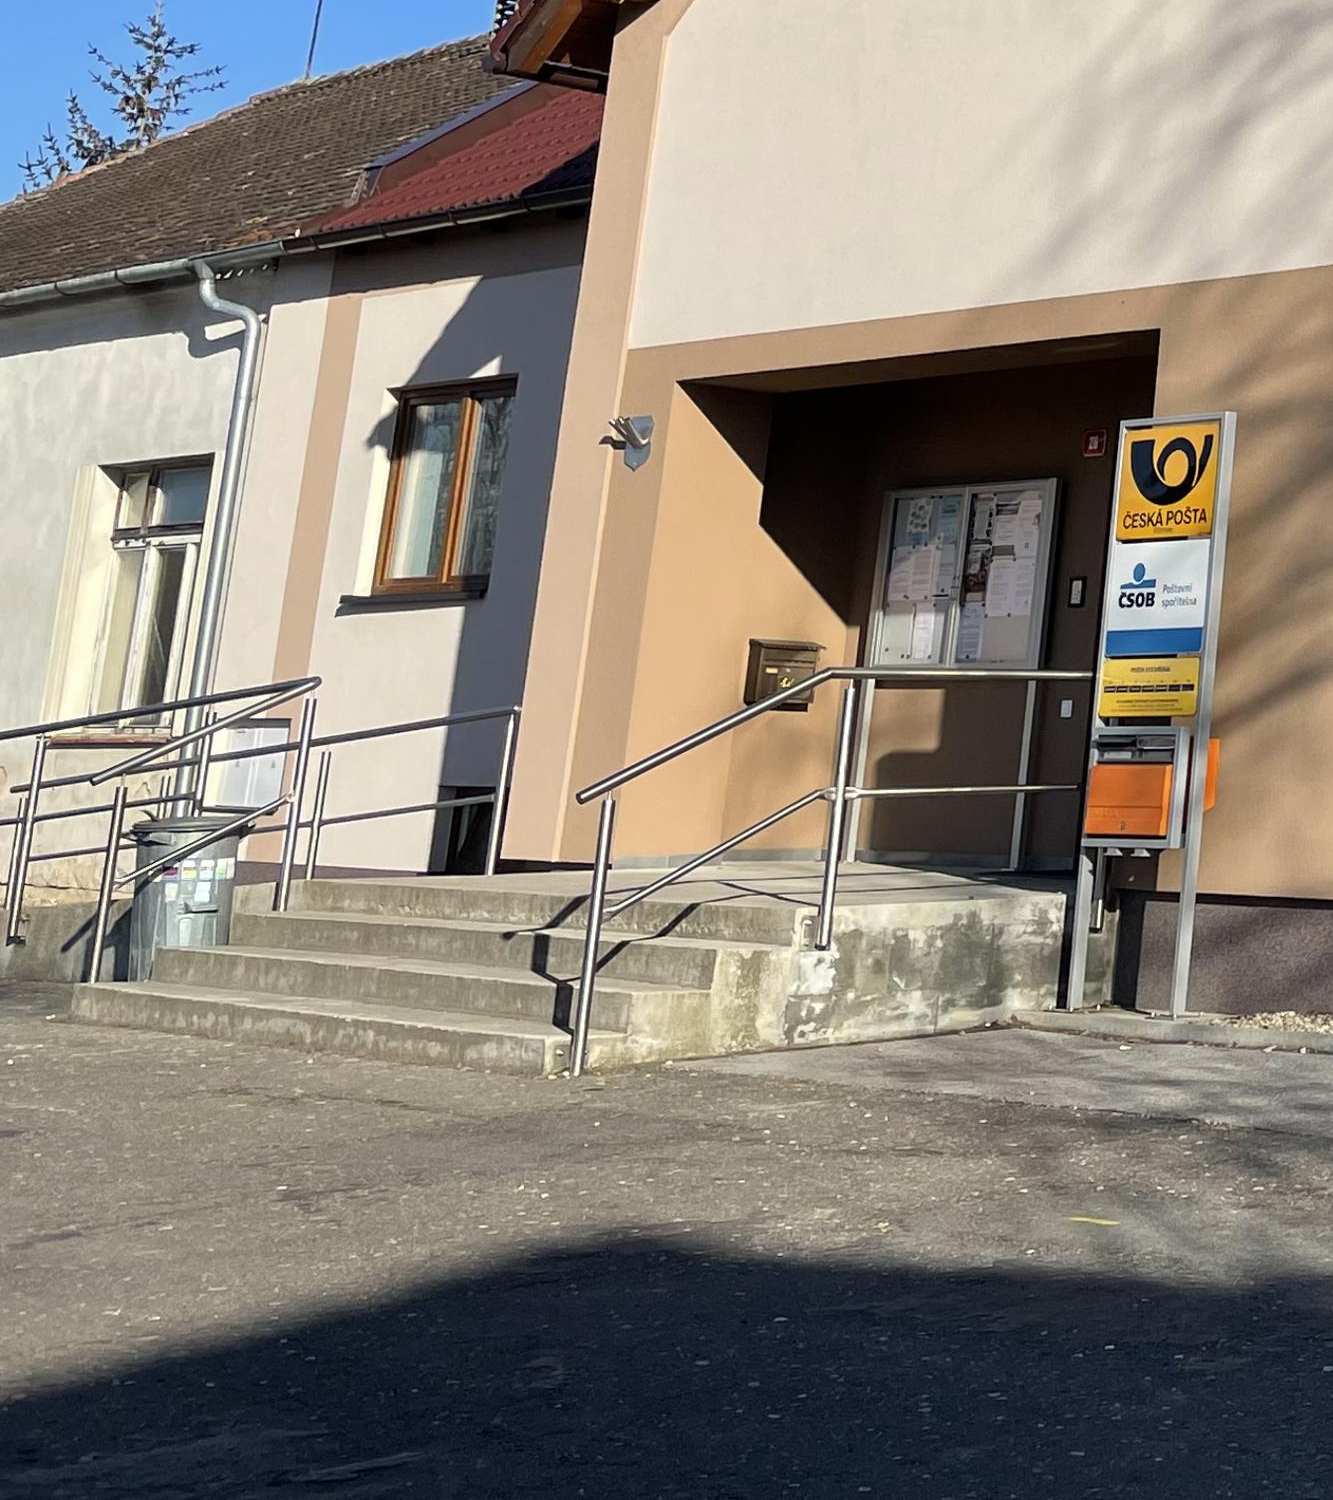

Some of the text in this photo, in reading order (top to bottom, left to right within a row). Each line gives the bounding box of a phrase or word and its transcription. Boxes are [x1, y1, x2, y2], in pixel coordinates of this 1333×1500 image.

[1123, 506, 1207, 530] ČESKÁ POŠTA
[1118, 591, 1156, 608] ČSOB
